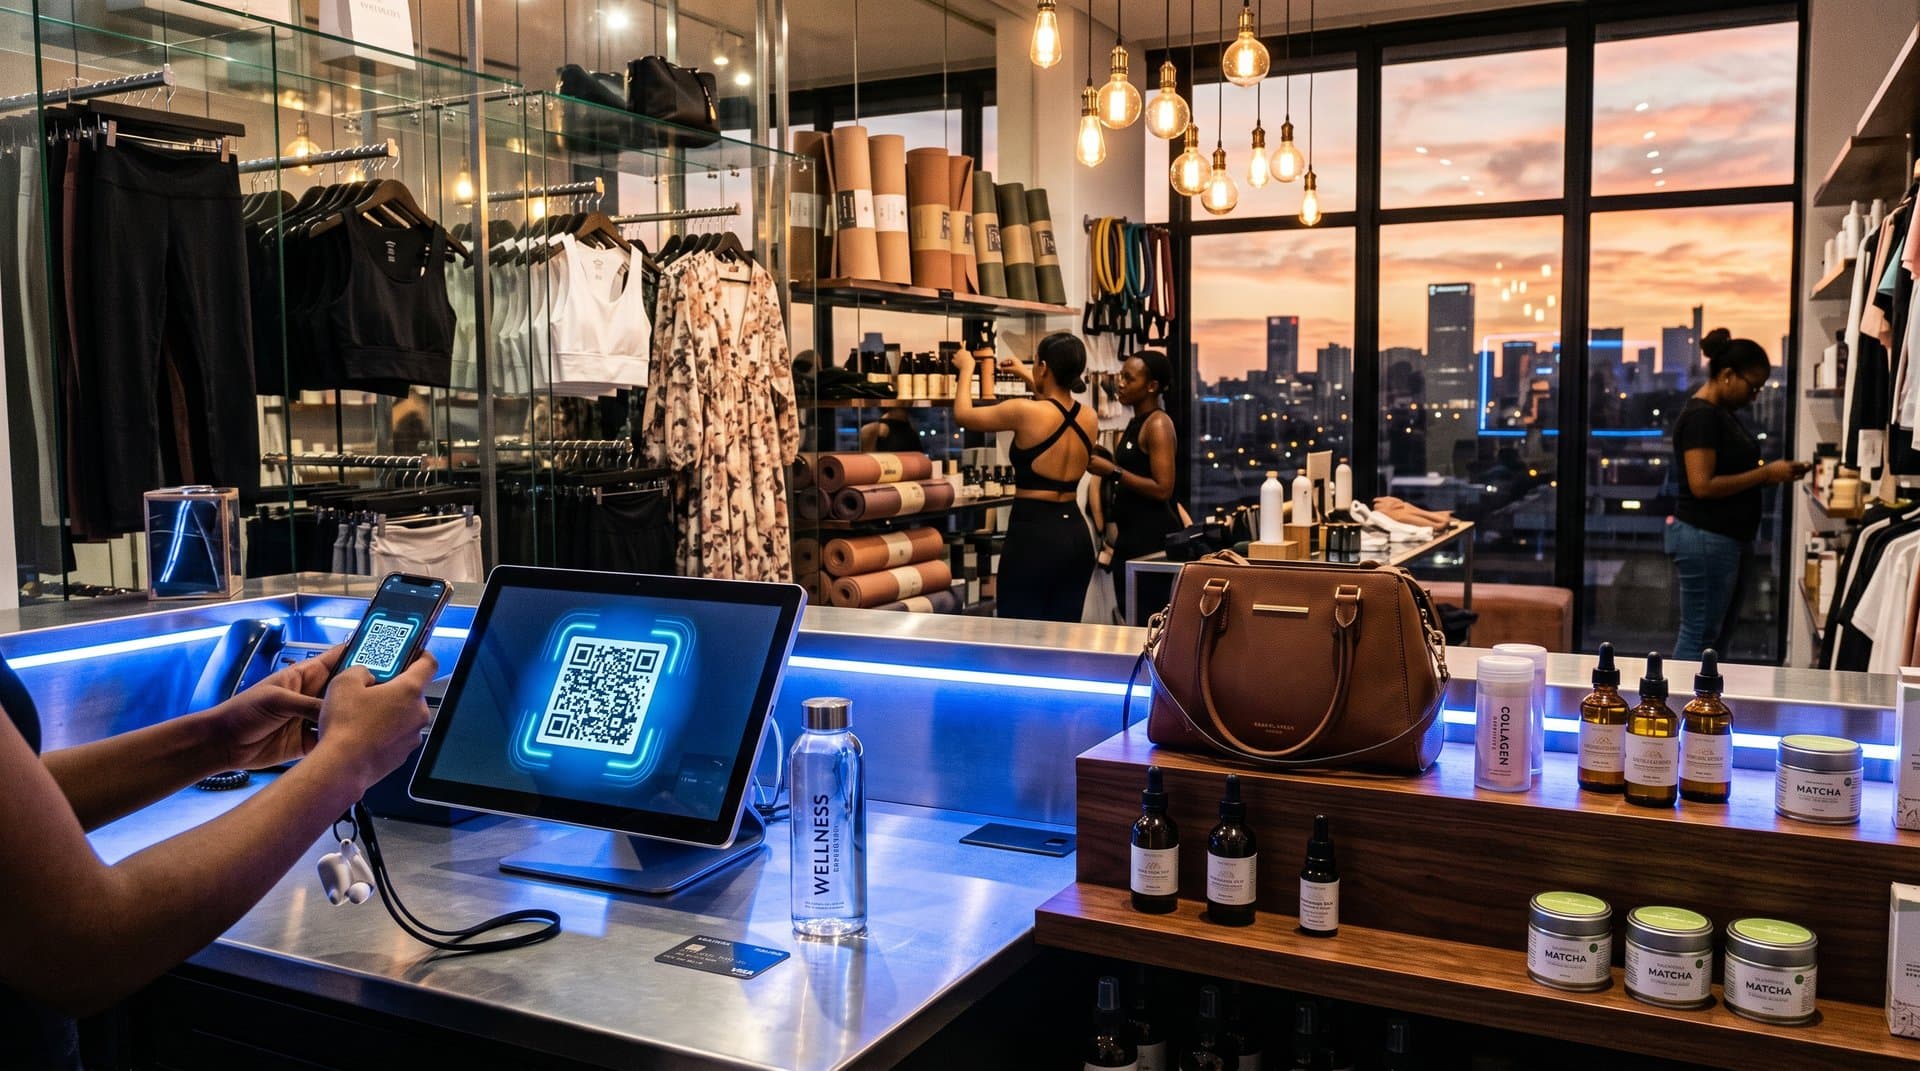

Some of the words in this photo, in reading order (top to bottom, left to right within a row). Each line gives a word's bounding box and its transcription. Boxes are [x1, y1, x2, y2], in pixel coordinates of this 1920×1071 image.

[1499, 706, 1511, 767] COLLAGEN
[1796, 784, 1842, 797] MATCHA
[813, 794, 830, 896] WELLNESS
[1545, 949, 1588, 963] MATCHA
[1647, 967, 1693, 980] MATCHA
[1745, 981, 1793, 996] MATCHA
